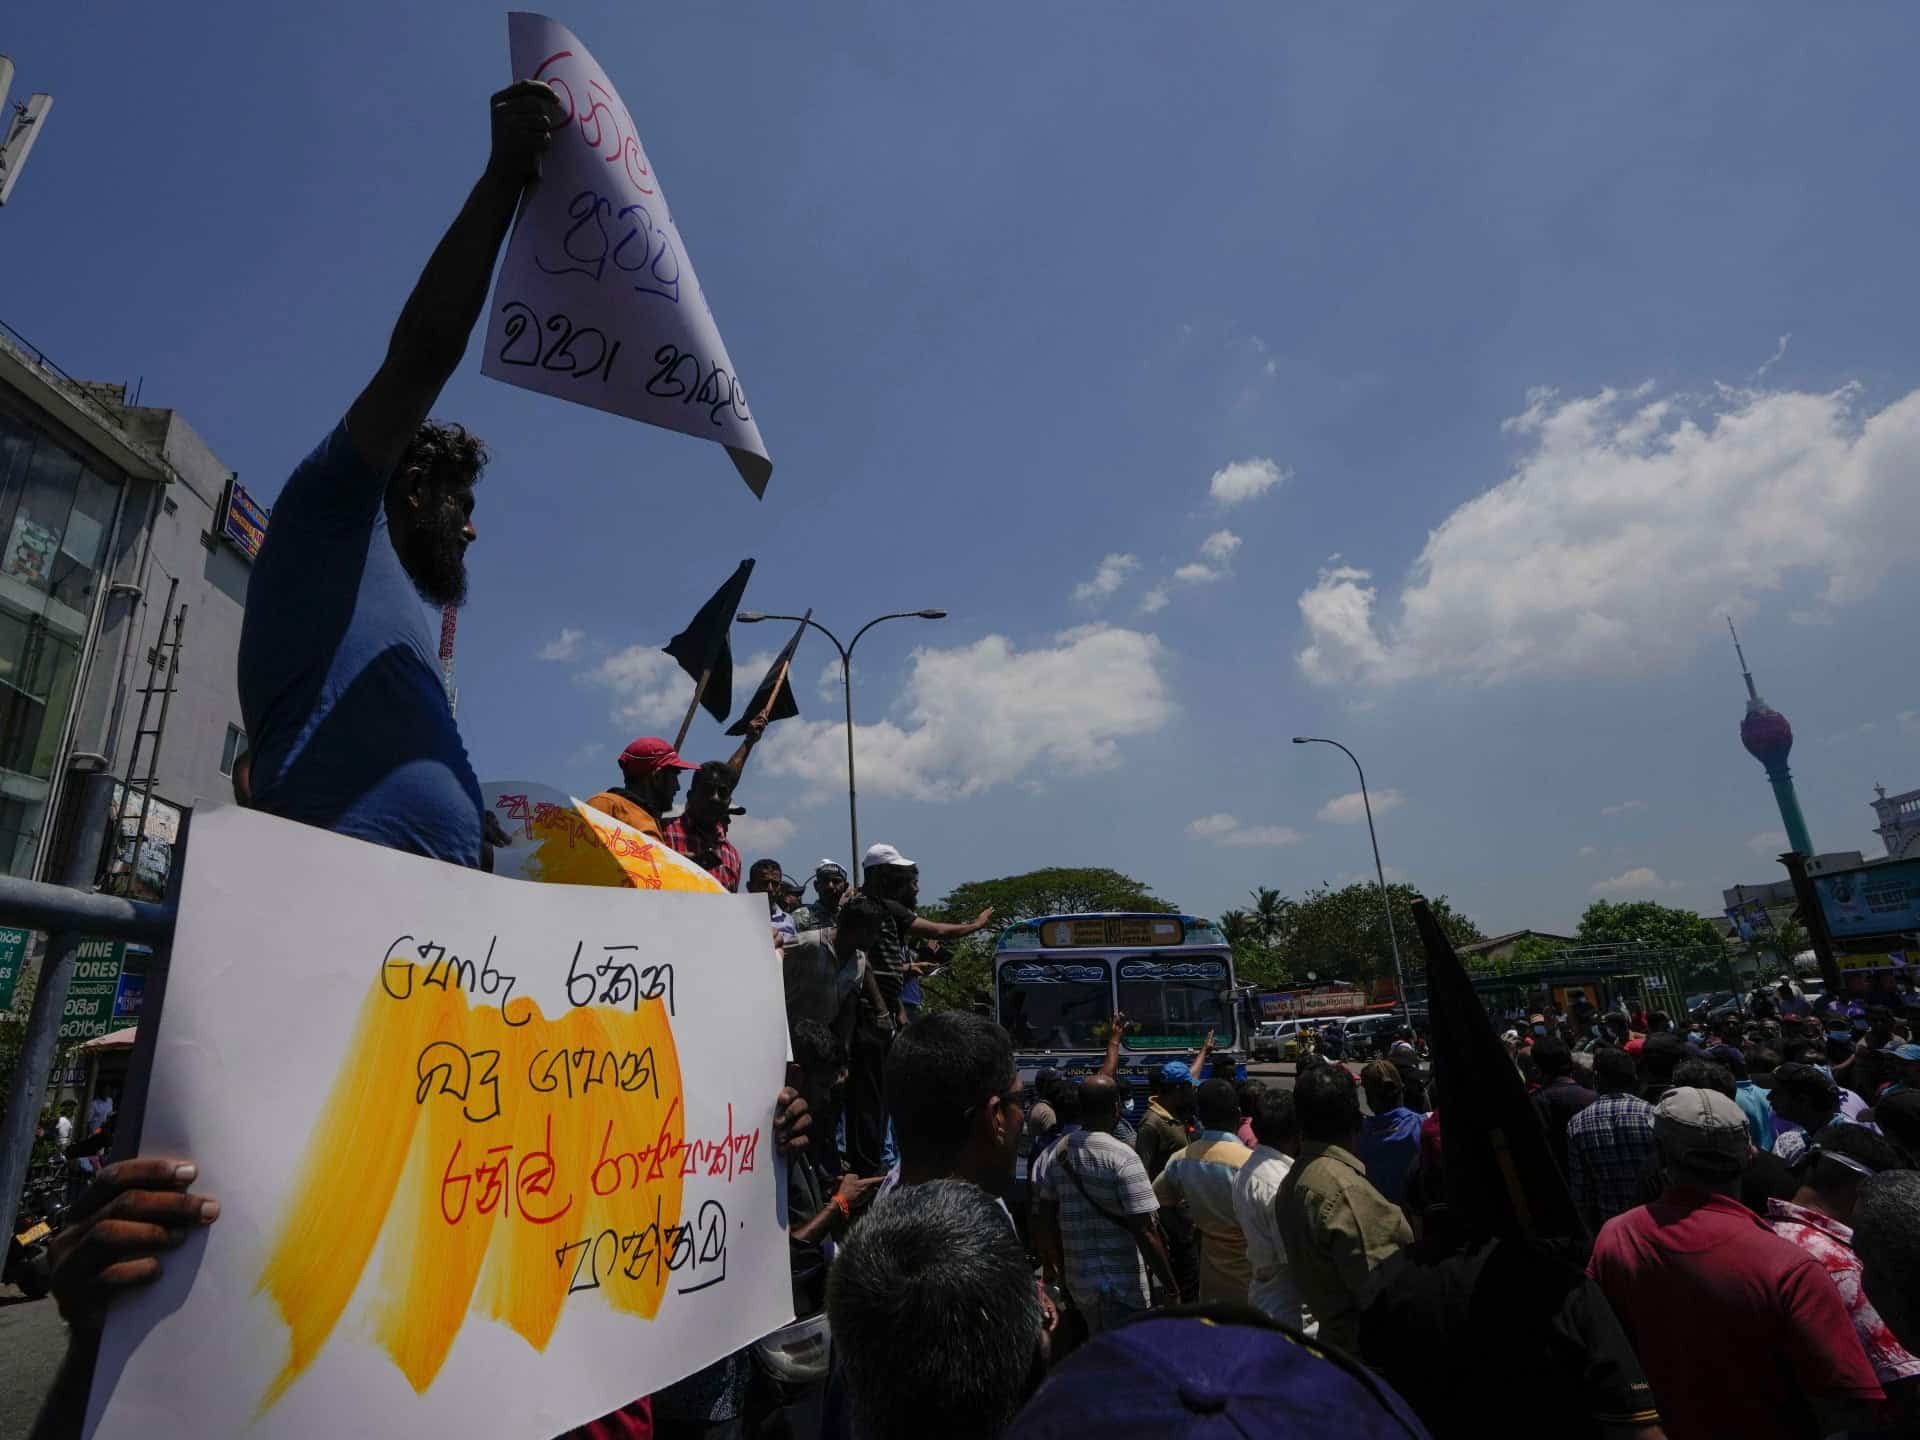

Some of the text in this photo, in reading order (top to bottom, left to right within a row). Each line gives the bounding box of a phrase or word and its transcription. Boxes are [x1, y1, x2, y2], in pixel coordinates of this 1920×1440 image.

[71, 961, 119, 978] TORES
[416, 1040, 501, 1123] බදු
[440, 1113, 573, 1225] රනිල්
